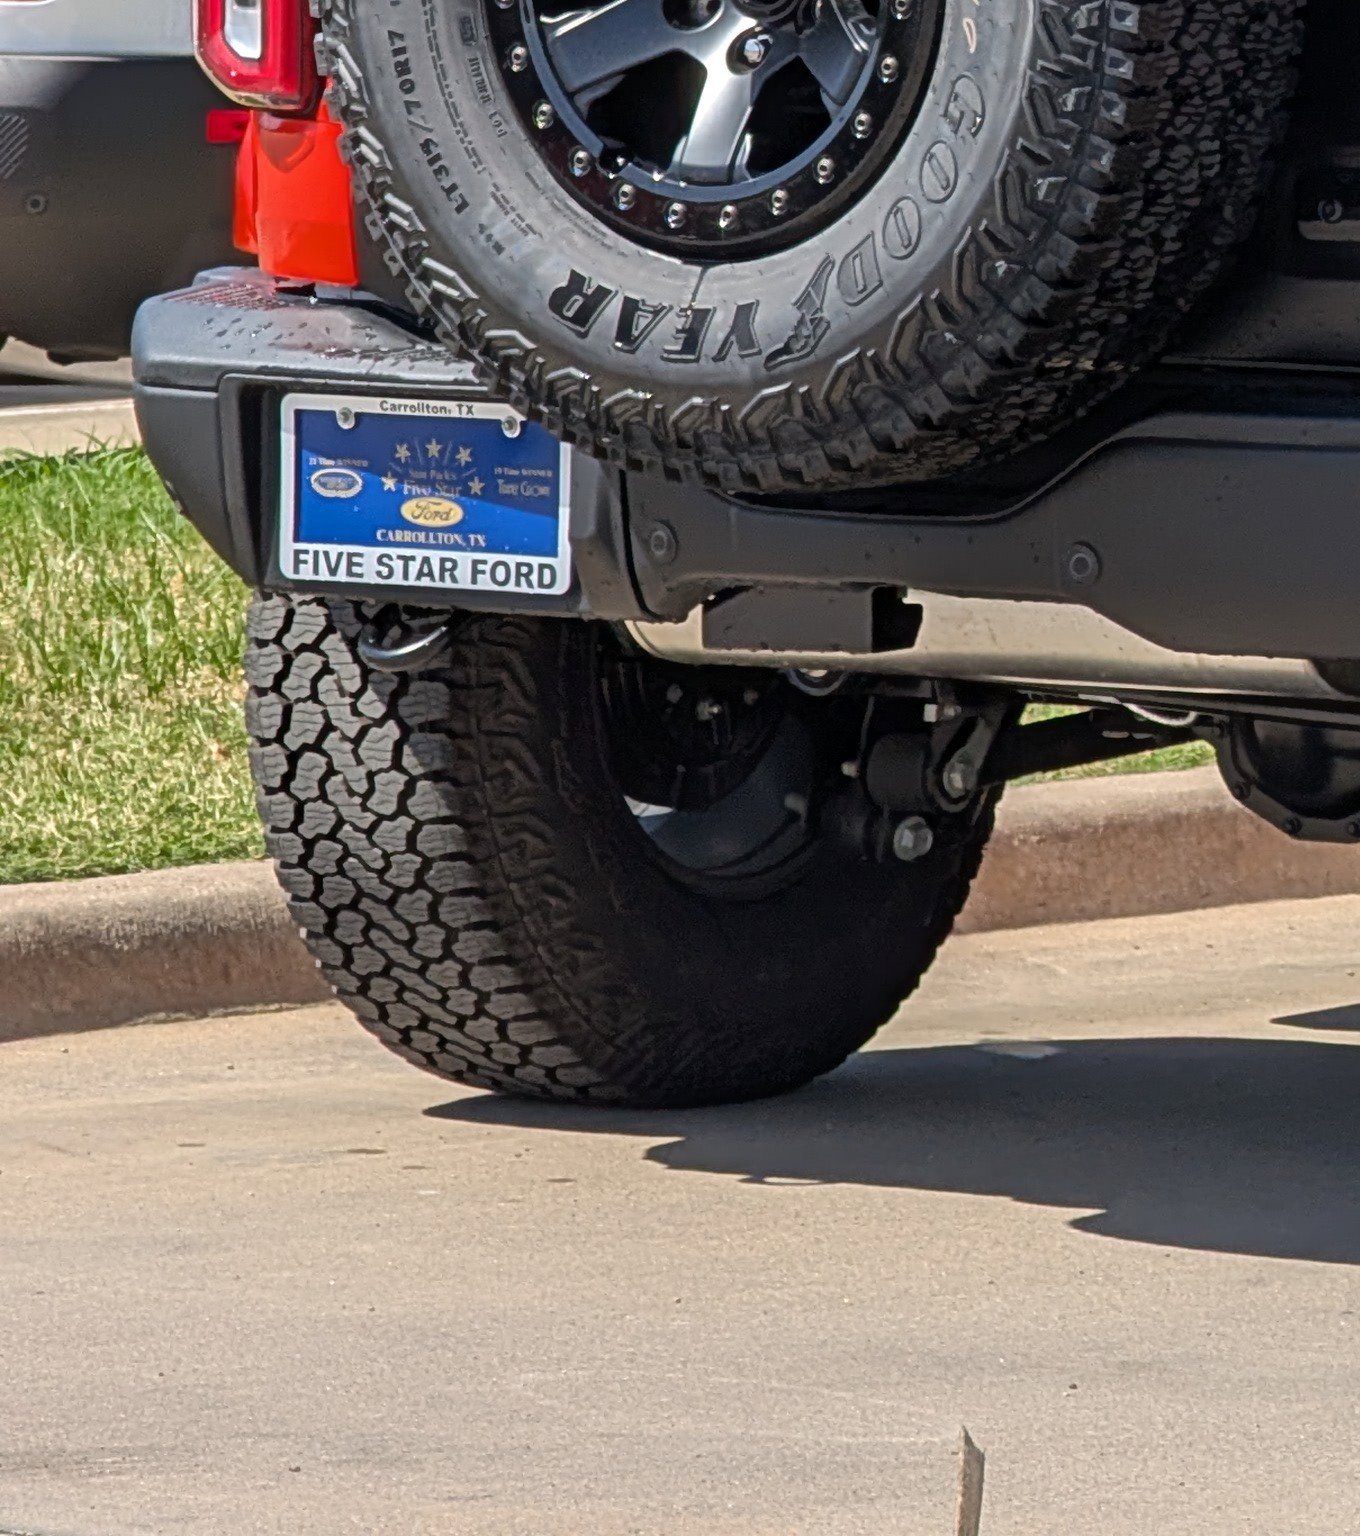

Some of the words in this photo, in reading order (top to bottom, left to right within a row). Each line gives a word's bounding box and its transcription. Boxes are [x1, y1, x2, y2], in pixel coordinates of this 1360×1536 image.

[548, 71, 988, 370] GOODYEAR
[457, 403, 475, 416] TX
[410, 501, 455, 522] Ford
[467, 533, 487, 547] TX
[292, 549, 364, 579] FIVE
[374, 553, 459, 584] STAR
[470, 558, 557, 590] FORD
